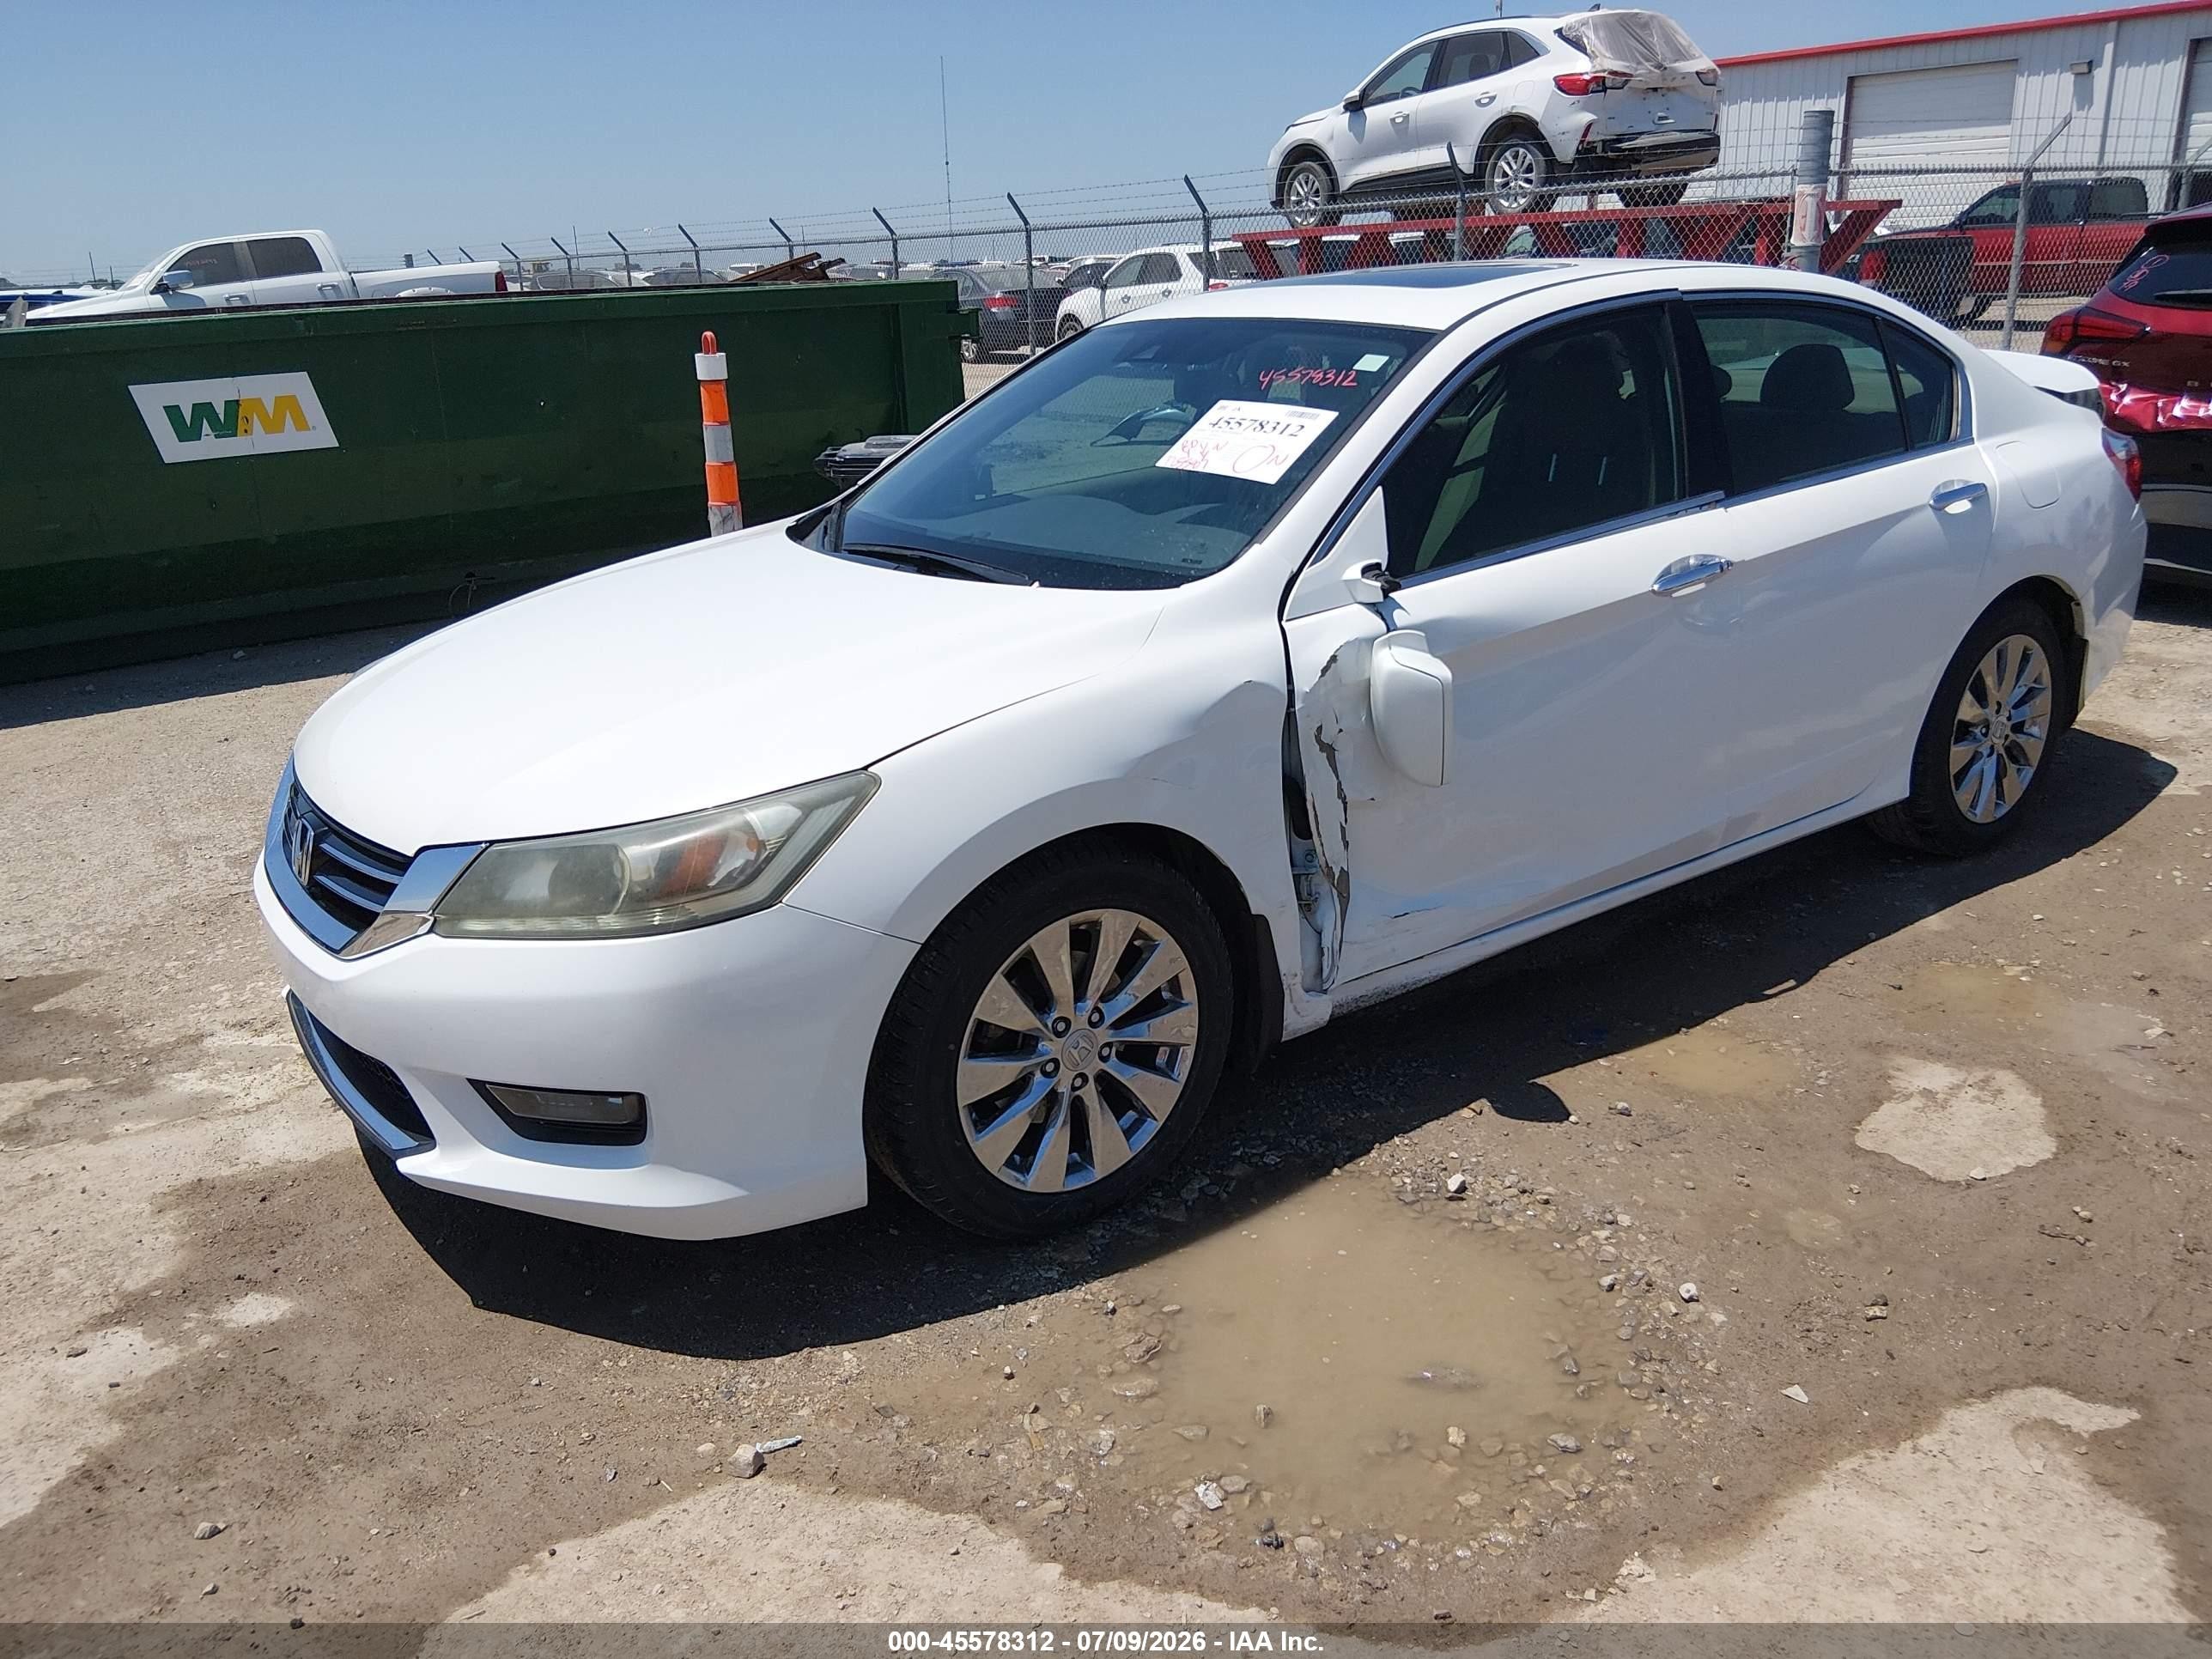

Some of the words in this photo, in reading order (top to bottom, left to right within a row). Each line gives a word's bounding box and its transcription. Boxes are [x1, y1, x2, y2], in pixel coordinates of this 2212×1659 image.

[1259, 367, 1358, 391] 45578312
[162, 394, 311, 443] WM
[1209, 416, 1305, 437] 45578312
